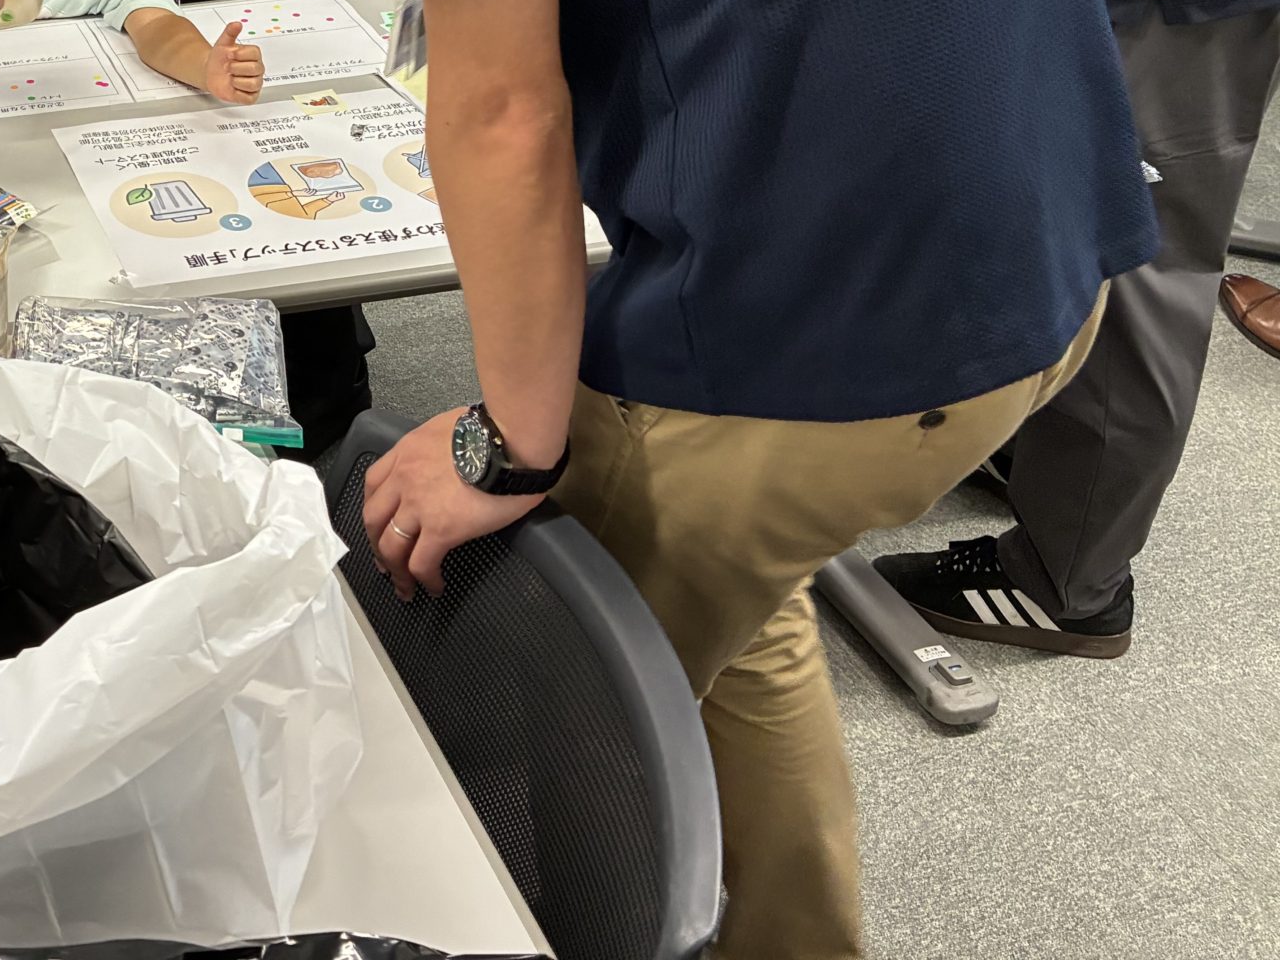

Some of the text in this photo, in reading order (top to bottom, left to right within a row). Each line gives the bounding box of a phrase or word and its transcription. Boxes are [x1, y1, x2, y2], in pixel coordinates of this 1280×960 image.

[216, 115, 314, 131] 安心安全に保管可能
[242, 123, 296, 135] 外出先でも
[92, 135, 189, 152] 森林の保全に貢献し
[252, 134, 304, 147] 密閉処理
[259, 141, 310, 154] 防臭袋で
[94, 146, 200, 165] ごみ処理もスマート
[116, 155, 189, 171] 環境に優しく
[368, 198, 385, 210] 2
[228, 217, 244, 228] 3
